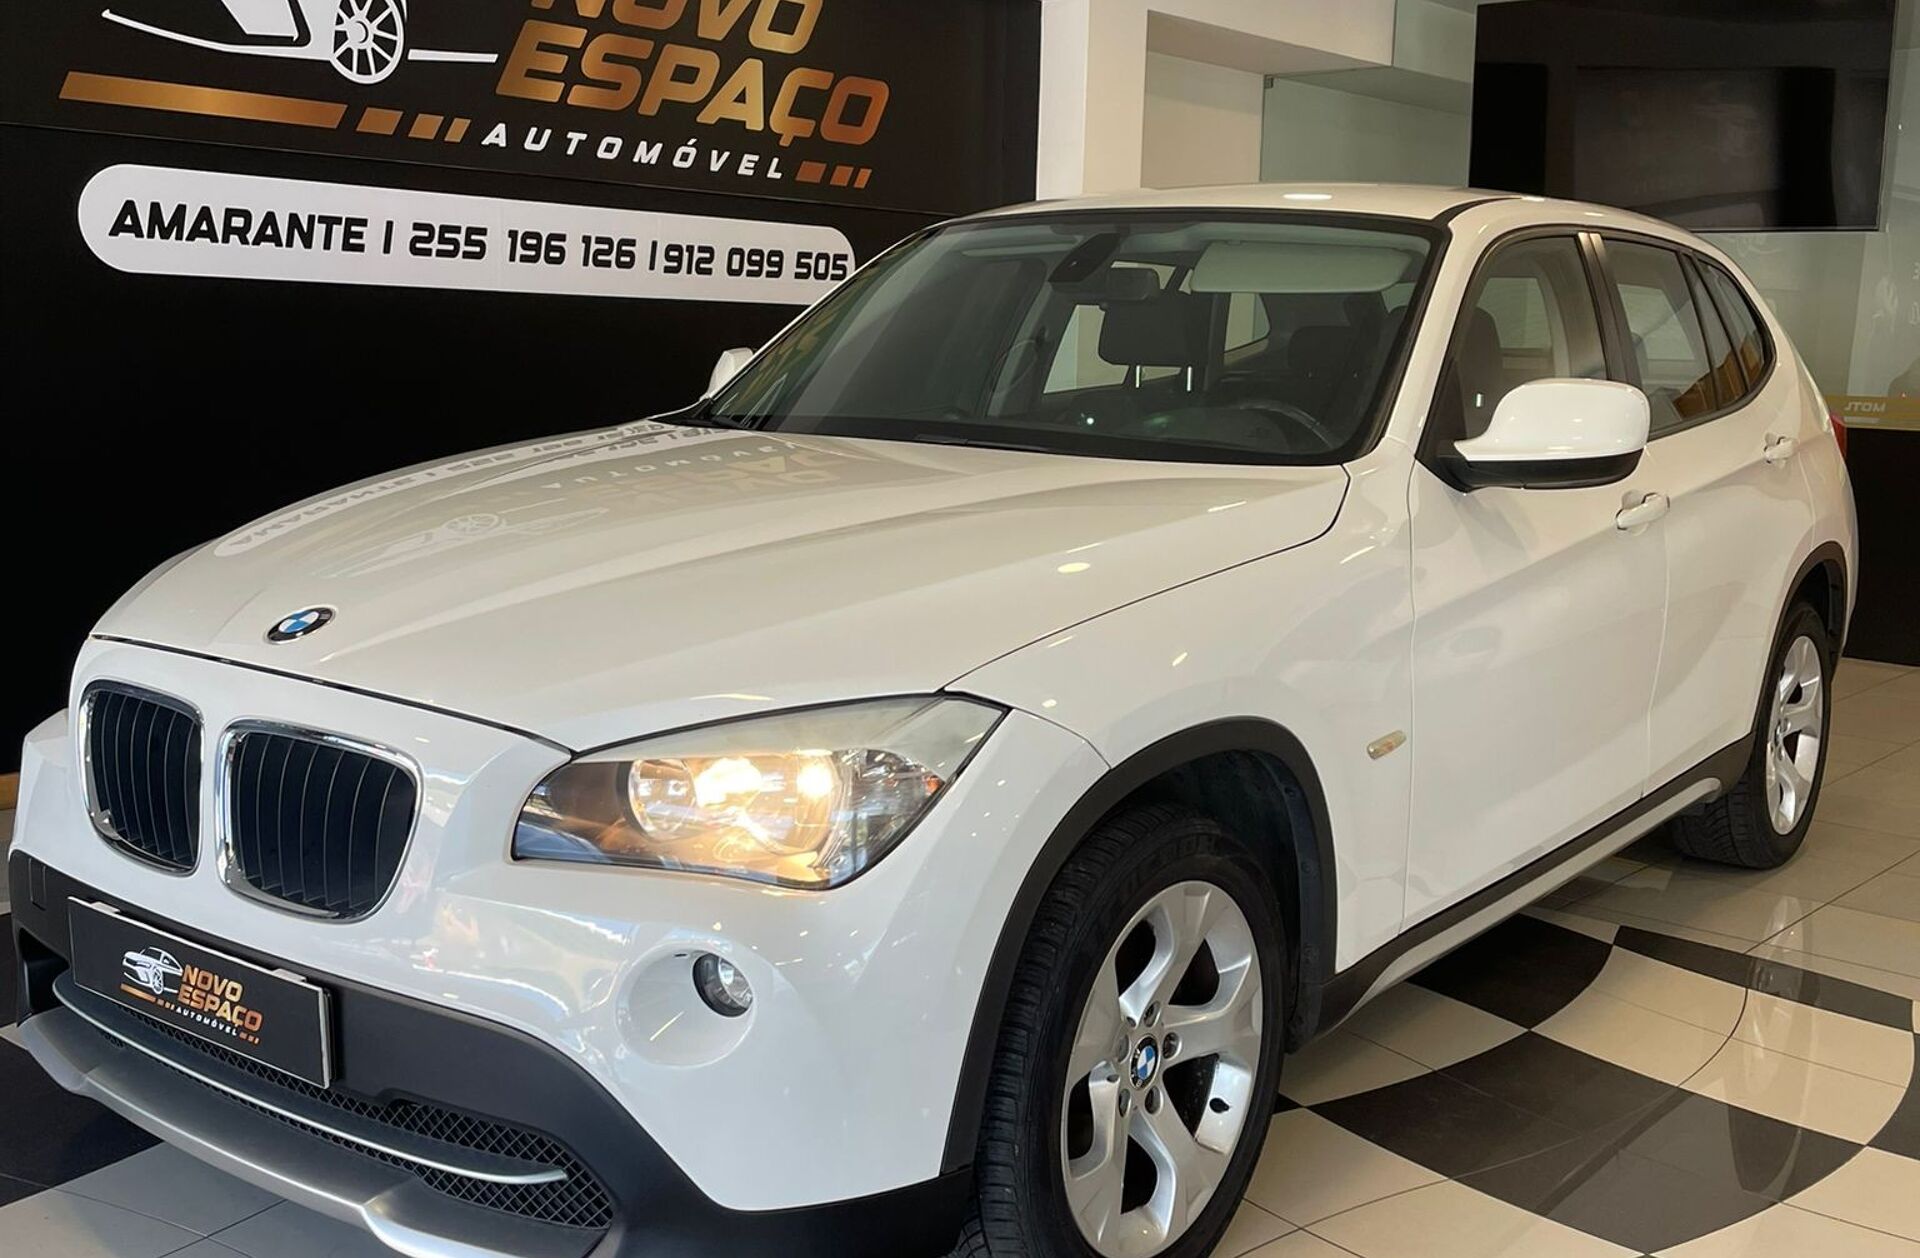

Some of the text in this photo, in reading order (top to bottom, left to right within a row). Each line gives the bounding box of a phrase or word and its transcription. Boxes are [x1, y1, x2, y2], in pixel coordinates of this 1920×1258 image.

[496, 19, 889, 147] ESPAÇO
[481, 122, 783, 180] AUTOMÓVEL
[108, 199, 369, 253] AMARANTE
[409, 222, 488, 260] 255
[507, 229, 567, 266] 196
[581, 235, 637, 270] 126
[663, 243, 715, 275] 912
[726, 247, 785, 279] 099
[794, 251, 849, 282] 505
[178, 983, 263, 1032] ESPAÇO
[182, 964, 243, 1002] NOVO
[176, 1006, 238, 1036] AUTOMÓVEL
